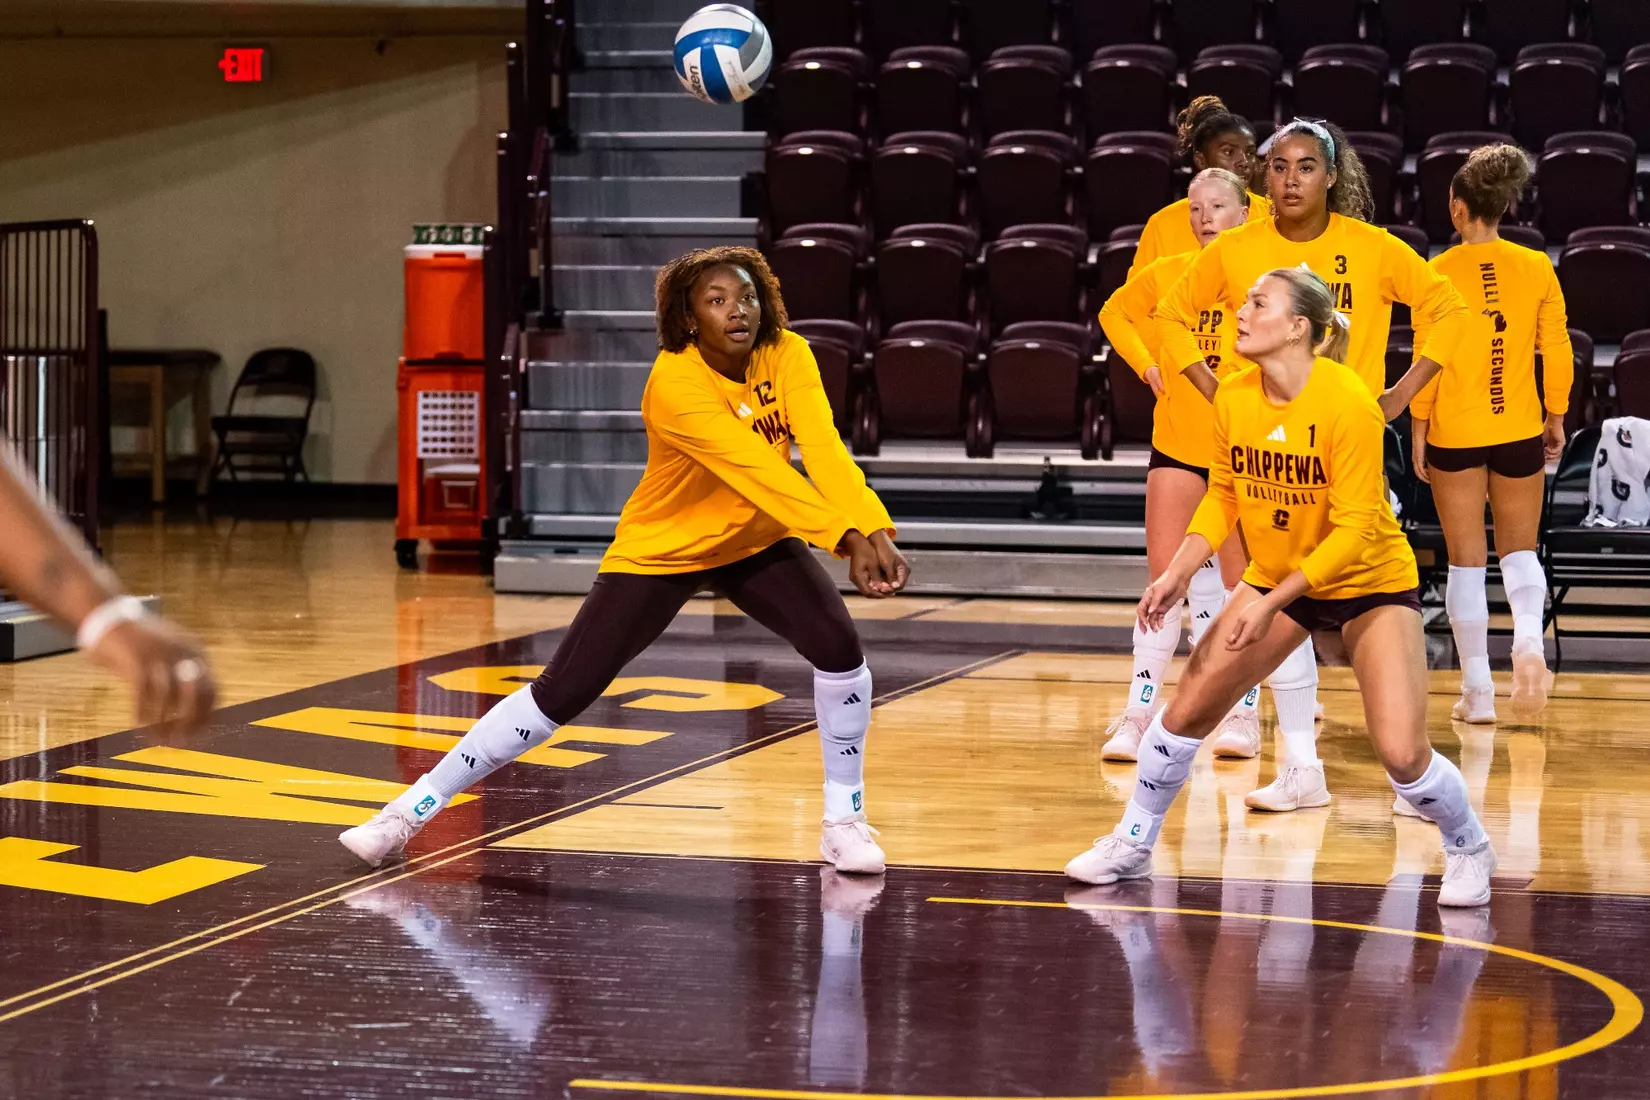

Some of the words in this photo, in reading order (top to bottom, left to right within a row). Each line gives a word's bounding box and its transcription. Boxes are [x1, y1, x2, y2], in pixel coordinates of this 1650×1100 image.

[225, 48, 263, 82] EXIT
[1334, 254, 1347, 275] 3
[1479, 262, 1500, 304] NULLI
[1191, 309, 1223, 333] PP
[1490, 337, 1505, 415] SECUNDUS
[753, 380, 777, 407] 12
[751, 410, 788, 445] WA
[1308, 423, 1316, 448] 1
[1230, 445, 1328, 485] CHIPPEWA
[1246, 483, 1317, 506] VOLLEYBALL
